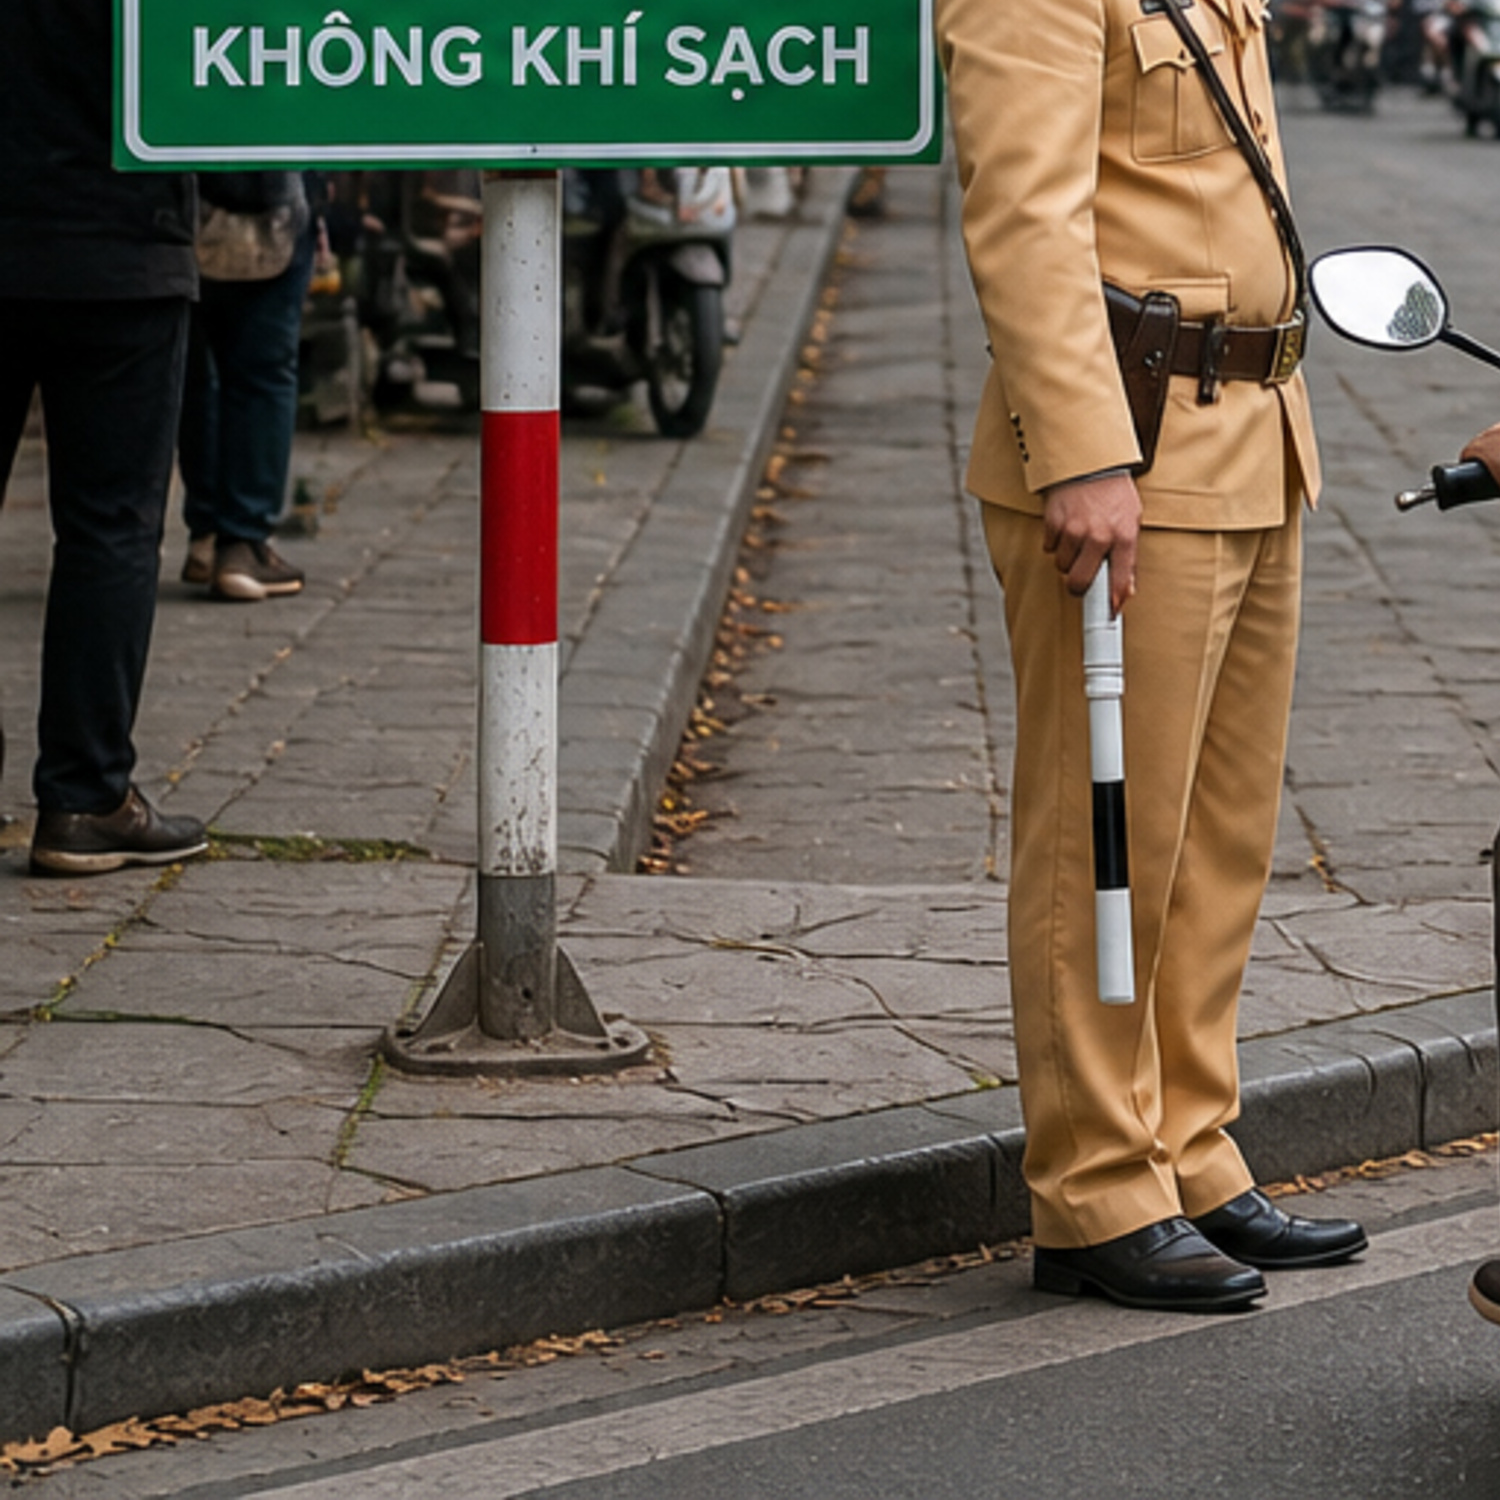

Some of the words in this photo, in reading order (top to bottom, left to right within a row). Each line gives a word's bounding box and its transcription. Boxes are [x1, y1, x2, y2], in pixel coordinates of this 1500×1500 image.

[193, 10, 483, 87] KHÔNG
[512, 10, 644, 86] KHÍ
[664, 25, 869, 101] SẠCH
